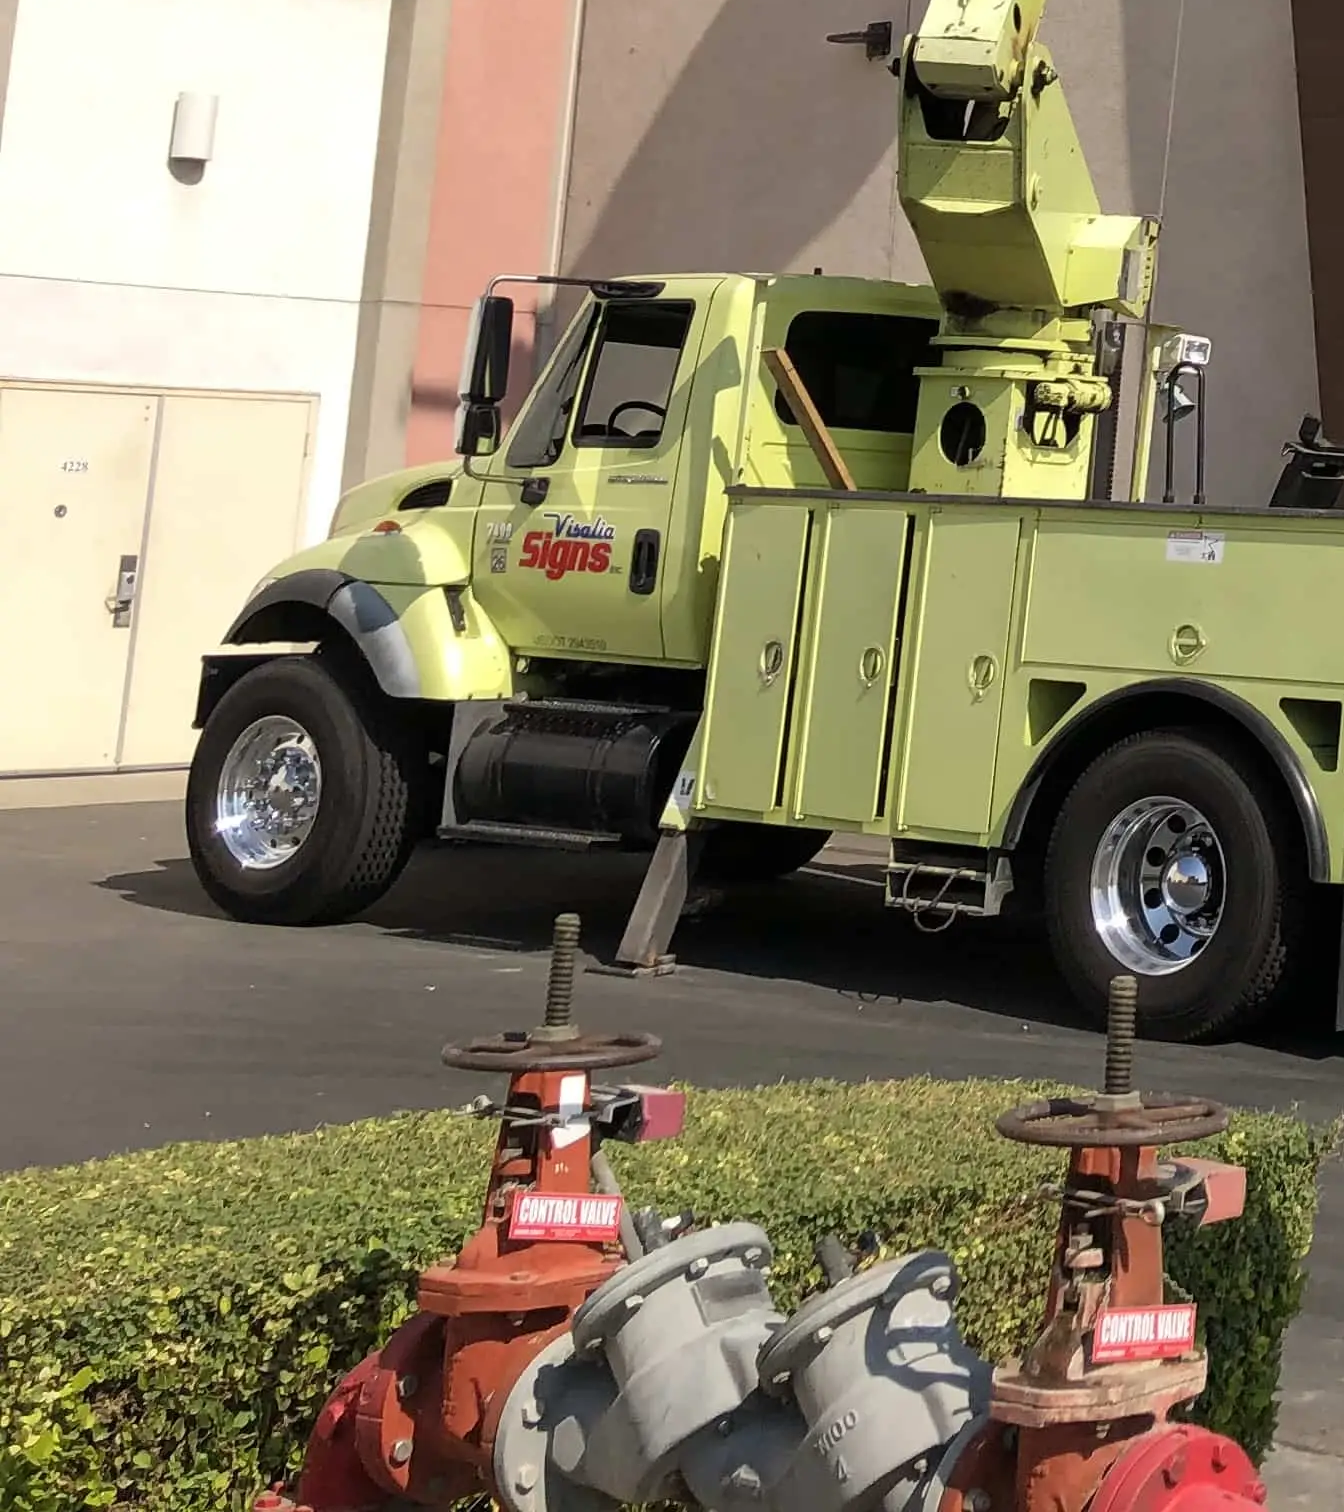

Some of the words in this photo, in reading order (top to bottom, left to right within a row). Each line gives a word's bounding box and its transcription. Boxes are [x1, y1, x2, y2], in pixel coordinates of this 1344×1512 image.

[543, 512, 615, 540] Visalia
[518, 530, 612, 580] Signs
[519, 1197, 578, 1224] CONTROL
[580, 1198, 618, 1225] VALVE
[1101, 1312, 1155, 1345] CONTROL
[1157, 1308, 1192, 1340] VALVE
